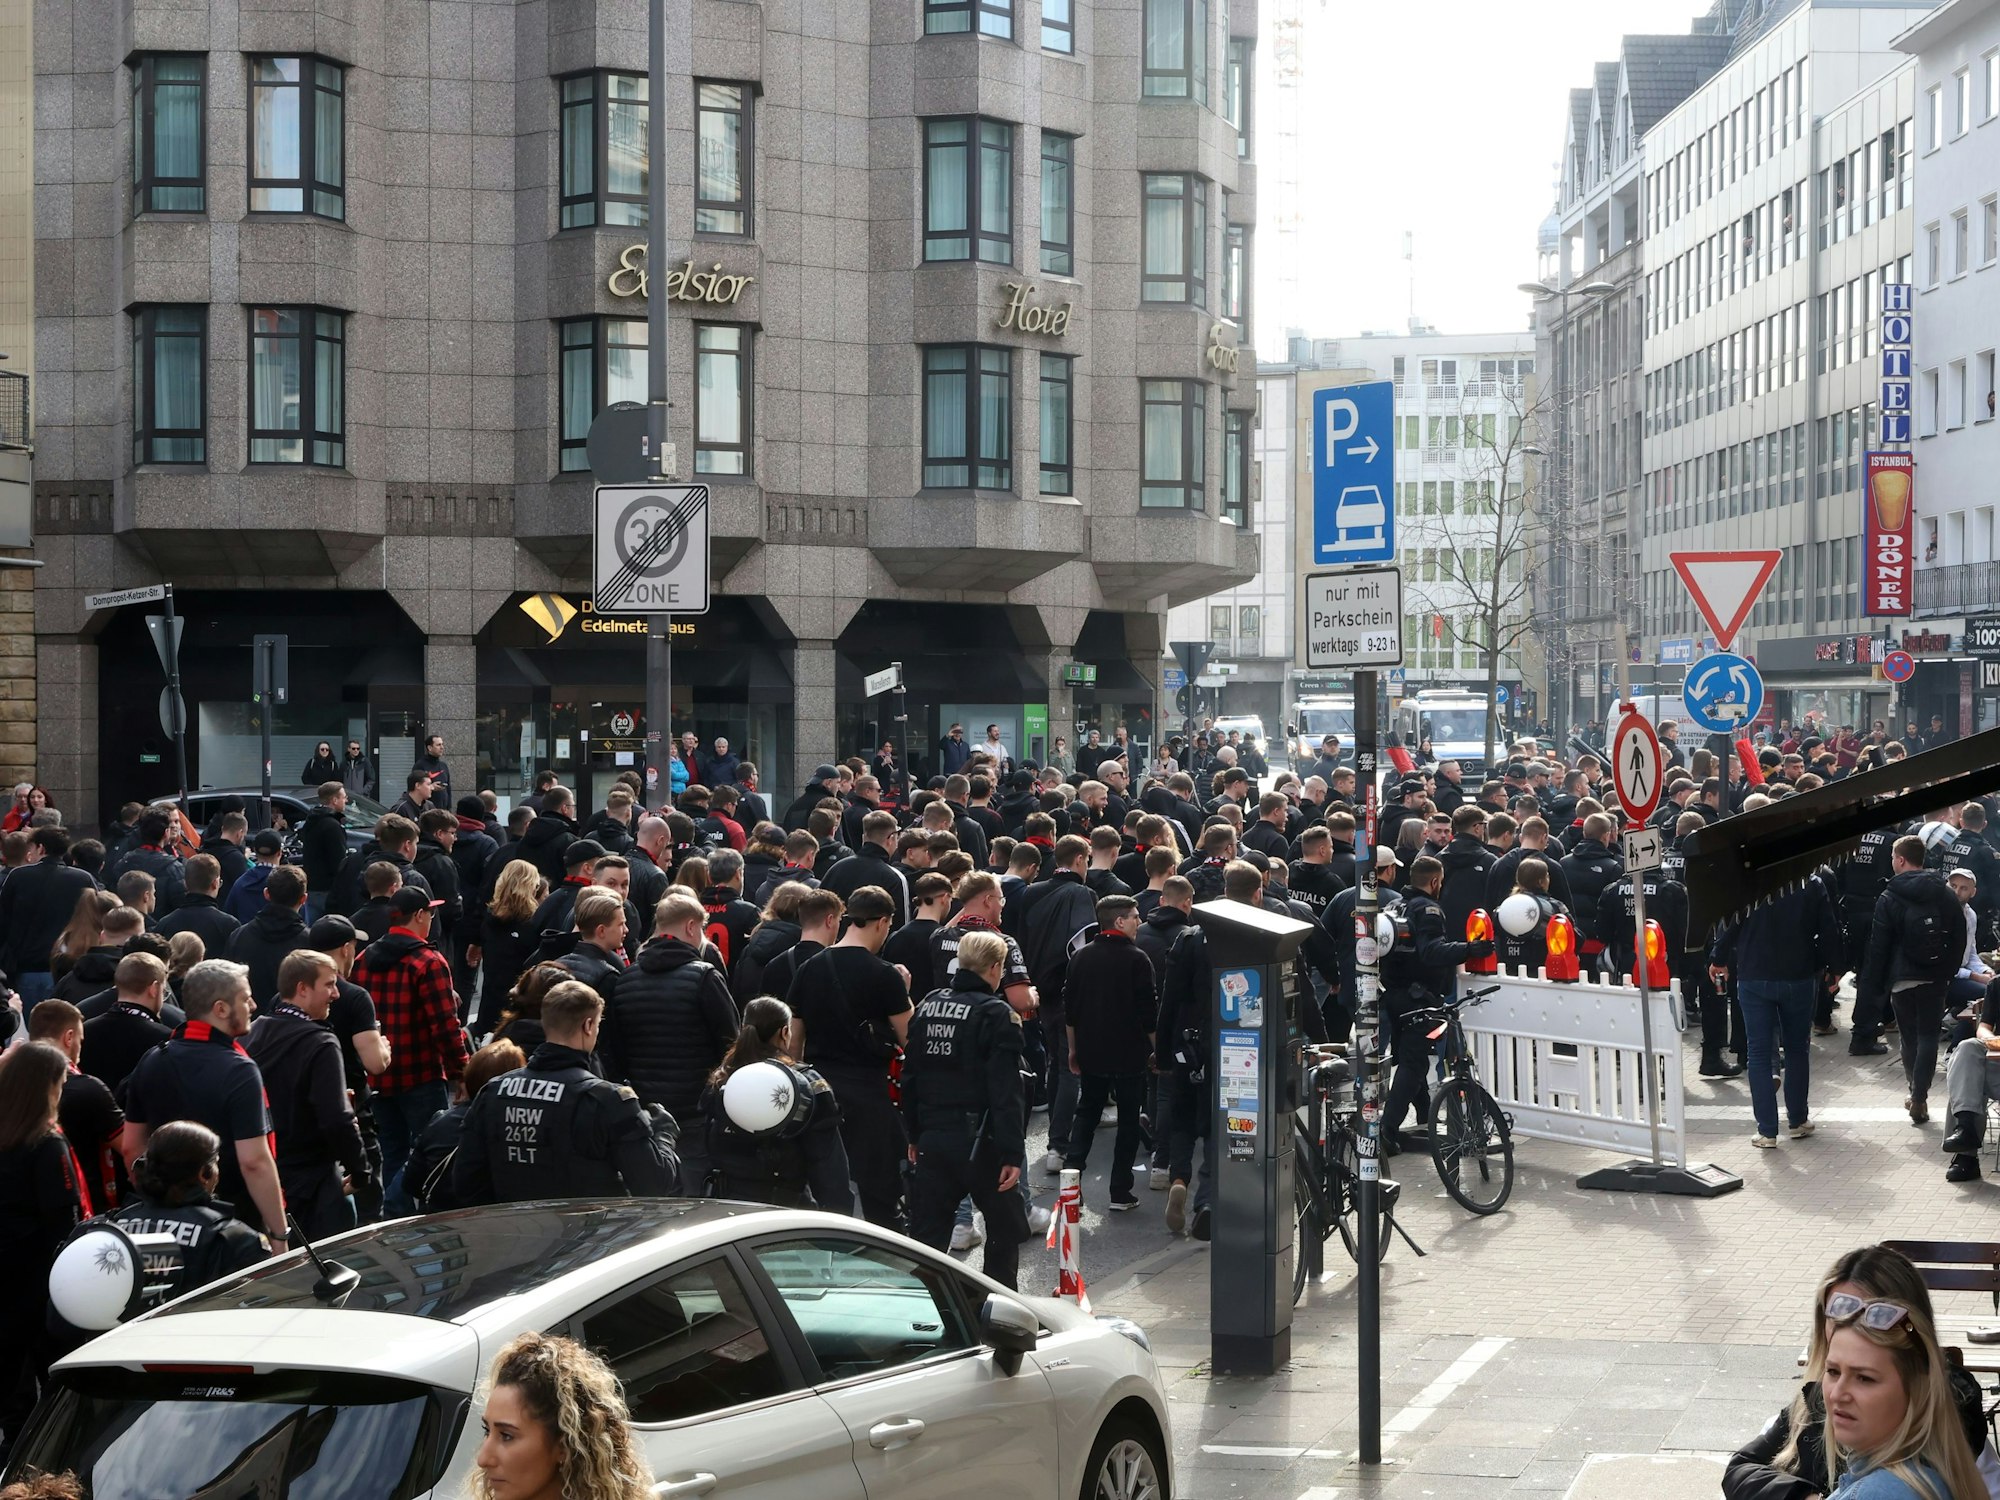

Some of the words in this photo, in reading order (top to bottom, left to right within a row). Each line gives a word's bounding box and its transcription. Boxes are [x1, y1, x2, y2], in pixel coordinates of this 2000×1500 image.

[608, 240, 754, 304] Exelsior
[998, 282, 1074, 337] Hotel
[1885, 284, 1910, 442] HOTEL
[1326, 398, 1359, 467] P
[1871, 456, 1911, 467] ISTANBUL
[630, 518, 672, 555] 30
[1877, 534, 1904, 610] DÖNER
[93, 588, 160, 606] Dompropst-Ketzer-Str.
[623, 584, 679, 603] ZONE
[1326, 586, 1349, 602] nur
[1357, 582, 1380, 600] mit
[581, 620, 695, 633] Edelmetaaus
[1314, 609, 1393, 629] Parkschein
[1312, 638, 1358, 657] werktags
[1367, 638, 1387, 652] 9-23
[1390, 639, 1396, 651] h
[617, 718, 628, 726] 20
[1618, 884, 1656, 895] POLZEI
[1508, 947, 1520, 956] RH
[919, 1001, 971, 1020] POLIZEI
[927, 1024, 955, 1038] NRW
[927, 1041, 952, 1055] 2613
[497, 1077, 565, 1102] POLIZEI
[505, 1106, 543, 1125] NRW
[505, 1126, 536, 1142] 2612
[508, 1146, 537, 1164] FLT
[142, 1254, 174, 1276] RW
